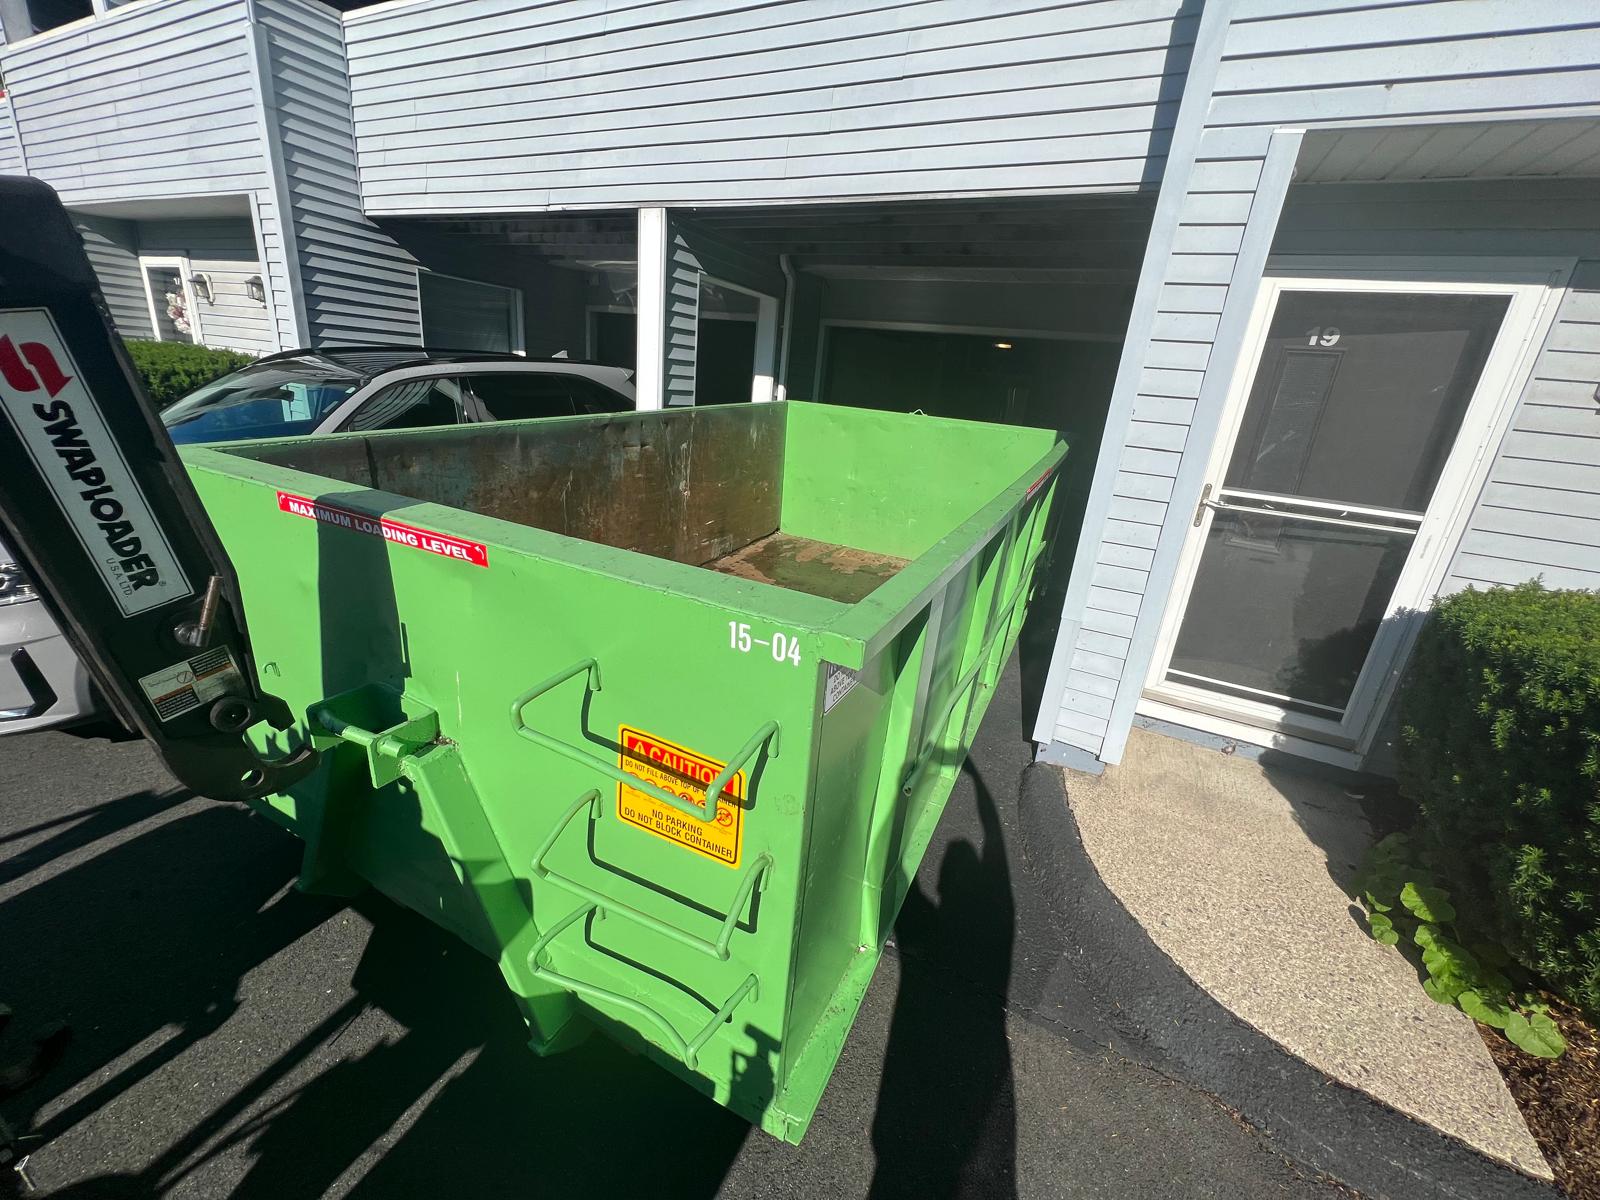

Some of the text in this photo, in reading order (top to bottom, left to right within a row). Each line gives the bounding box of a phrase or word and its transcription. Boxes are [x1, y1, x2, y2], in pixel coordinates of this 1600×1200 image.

[1305, 326, 1341, 347] 19
[33, 400, 160, 591] SWAPLOADER
[288, 501, 473, 562] MAXIMUM LOADING LEVEL
[728, 620, 802, 667] 15-04
[660, 772, 679, 786] ABOVE
[624, 806, 733, 859] DO NOT BLOCK CONTAINER
[652, 808, 664, 821] NO
[666, 814, 703, 837] PARKING
